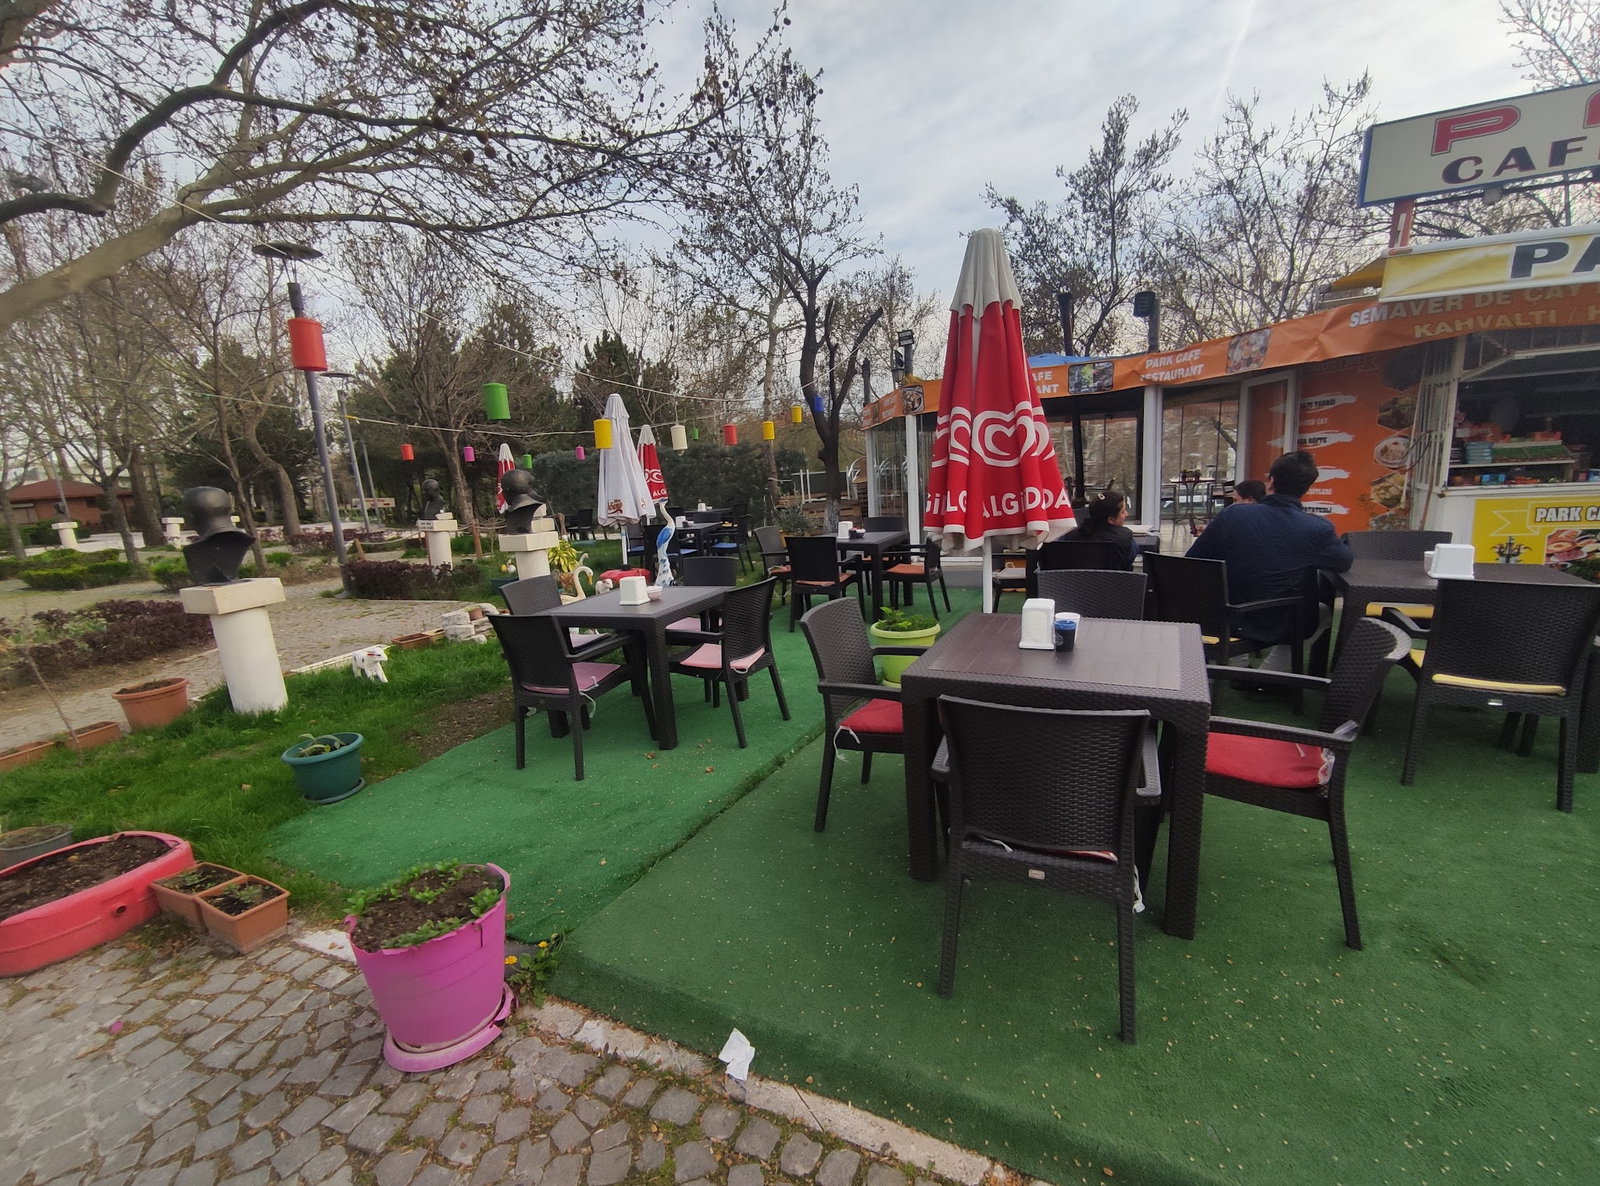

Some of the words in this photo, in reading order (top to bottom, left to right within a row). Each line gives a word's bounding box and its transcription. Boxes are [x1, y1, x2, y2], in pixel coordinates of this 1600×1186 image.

[1442, 136, 1600, 184] CAF
[1350, 294, 1463, 328] SEMAVER
[1474, 292, 1512, 308] DE
[1415, 309, 1557, 339] KAHVALTI
[1145, 355, 1173, 369] PARK
[1175, 349, 1201, 363] CAFE
[1534, 506, 1582, 522] PARK
